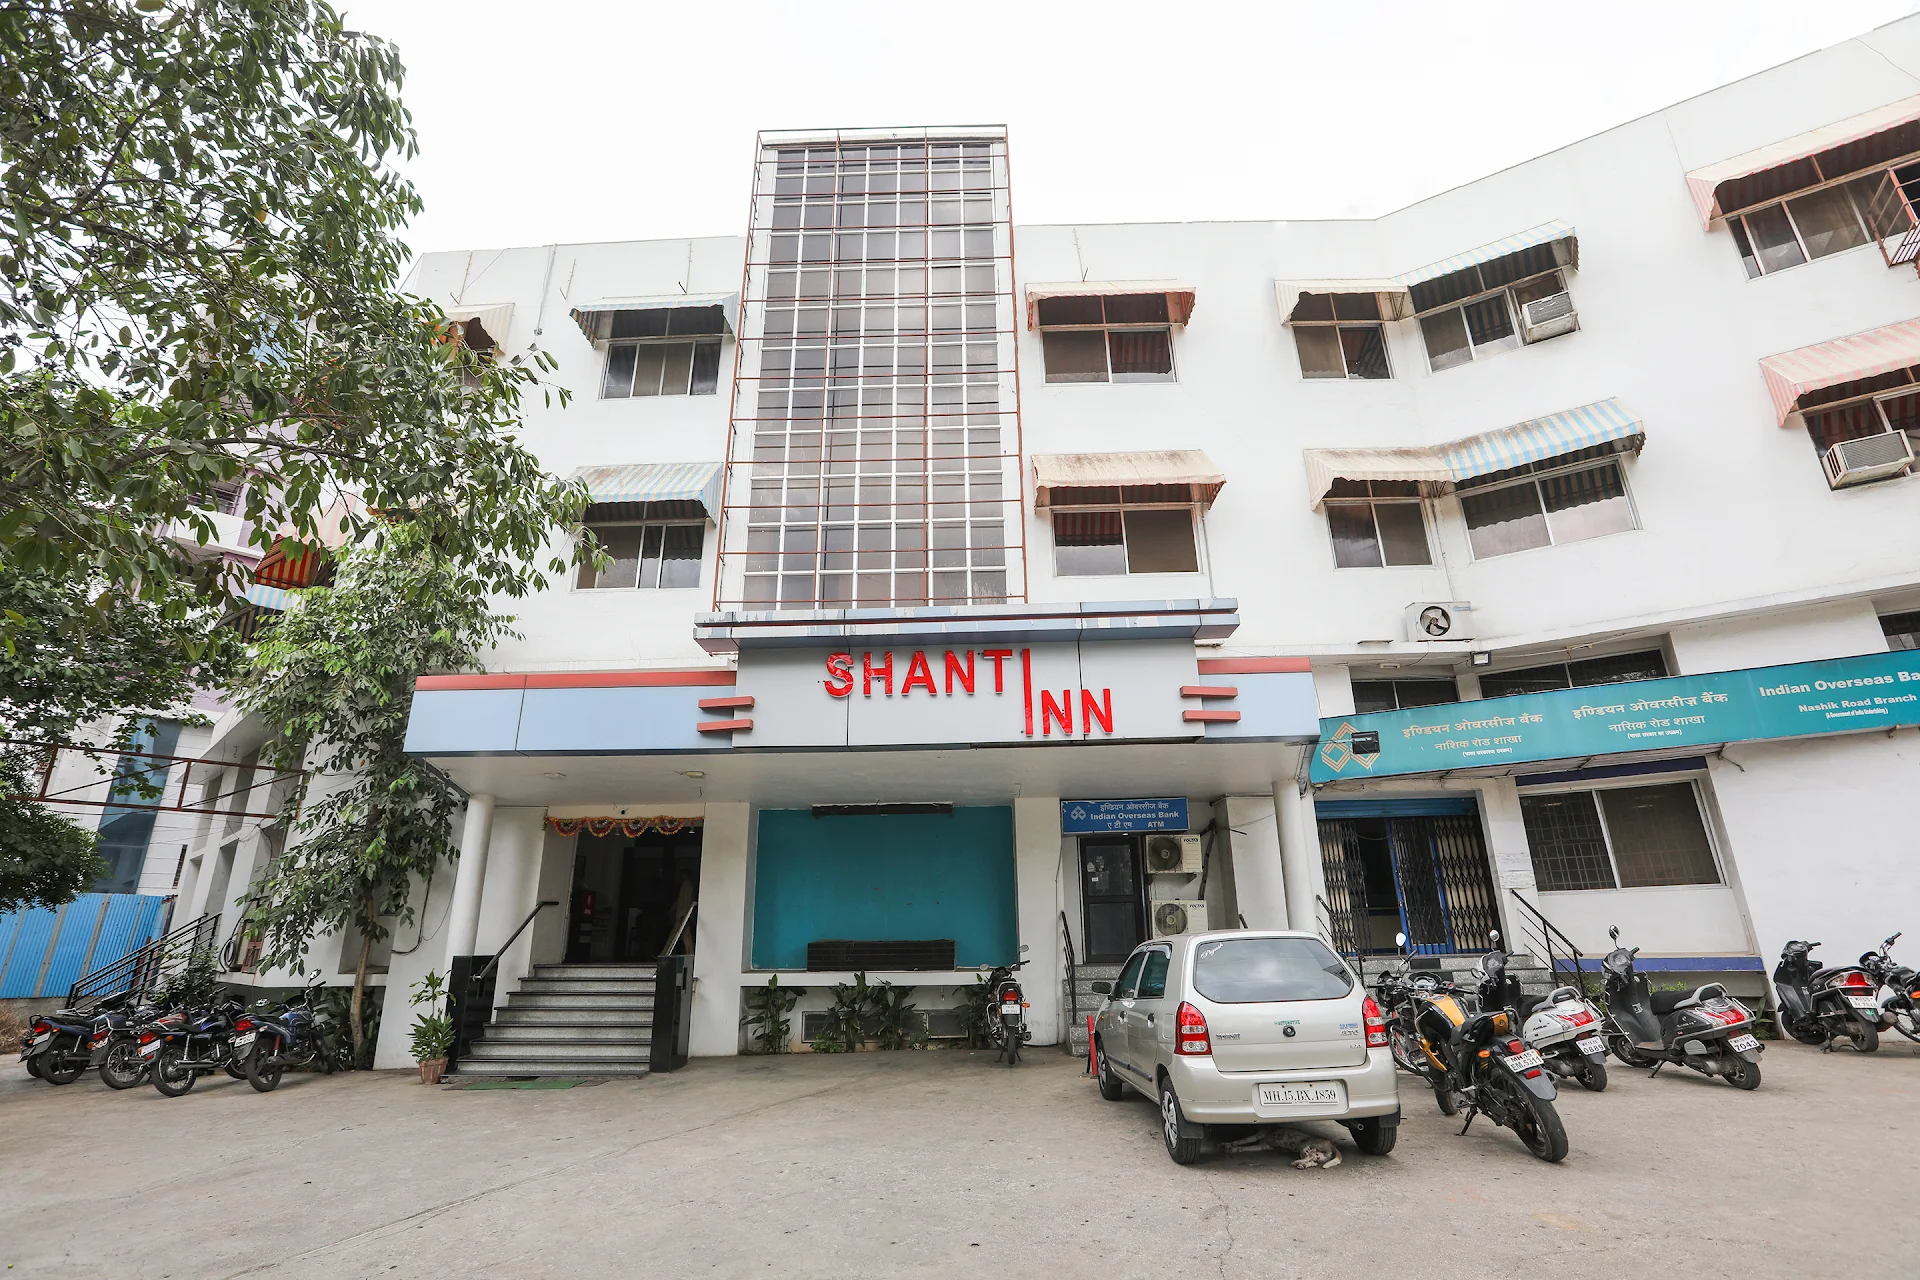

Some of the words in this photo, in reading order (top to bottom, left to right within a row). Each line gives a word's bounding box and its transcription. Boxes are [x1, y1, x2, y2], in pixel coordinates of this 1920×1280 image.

[1759, 683, 1811, 697] Indian
[1814, 673, 1895, 691] Overseas
[1798, 701, 1839, 713] Nashik
[1841, 698, 1872, 709] Road
[1873, 693, 1917, 705] Branch
[1572, 704, 1625, 720] इण्डियन
[1402, 723, 1450, 738] इण्डियन
[1608, 720, 1647, 733] नासिक
[1649, 718, 1670, 728] रोड
[1673, 715, 1705, 726] शाखा
[1434, 739, 1470, 751] नाशिक
[1471, 738, 1491, 748] रोड
[1493, 735, 1522, 744] शाखा
[1118, 812, 1157, 820] Overseas
[1158, 811, 1179, 819] Bank
[1734, 1040, 1758, 1051] 7043
